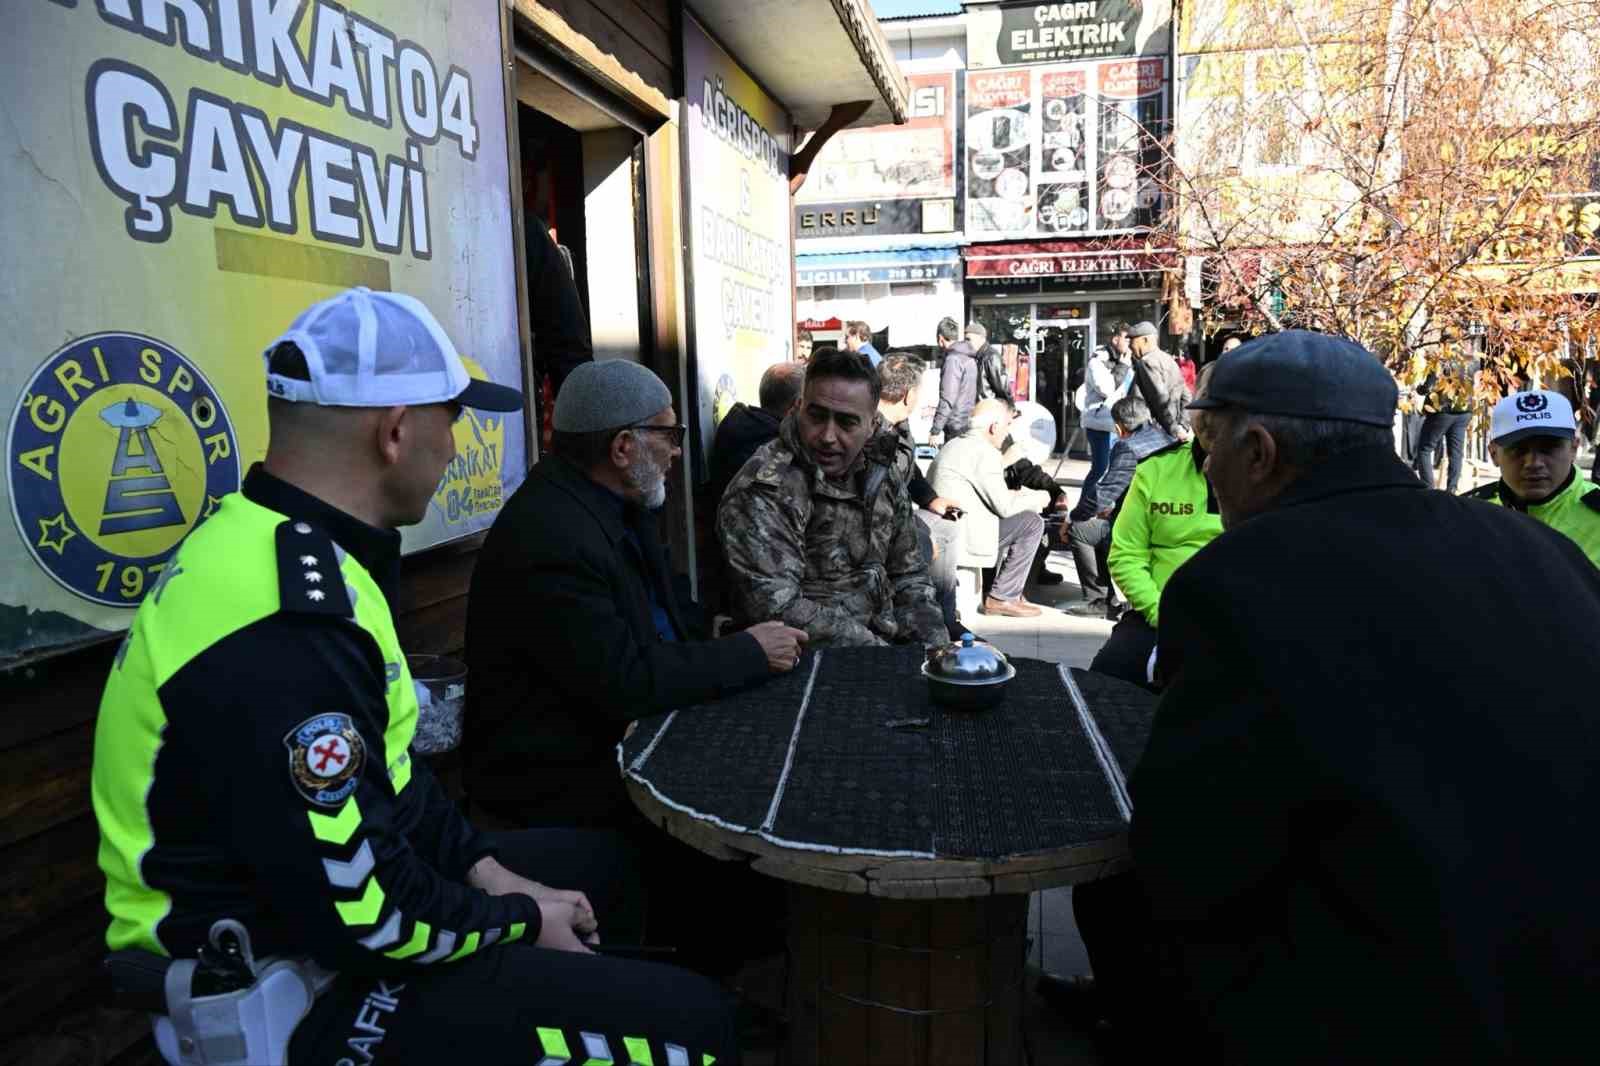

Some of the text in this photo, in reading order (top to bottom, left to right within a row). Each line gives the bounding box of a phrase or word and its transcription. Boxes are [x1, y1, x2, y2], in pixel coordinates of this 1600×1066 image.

[1011, 18, 1126, 51] ELEKTRİK
[86, 58, 431, 259] ÇAYEVİ
[1009, 255, 1137, 276] ÇAĞRI ELEKTRİK
[139, 348, 230, 465] SPOR
